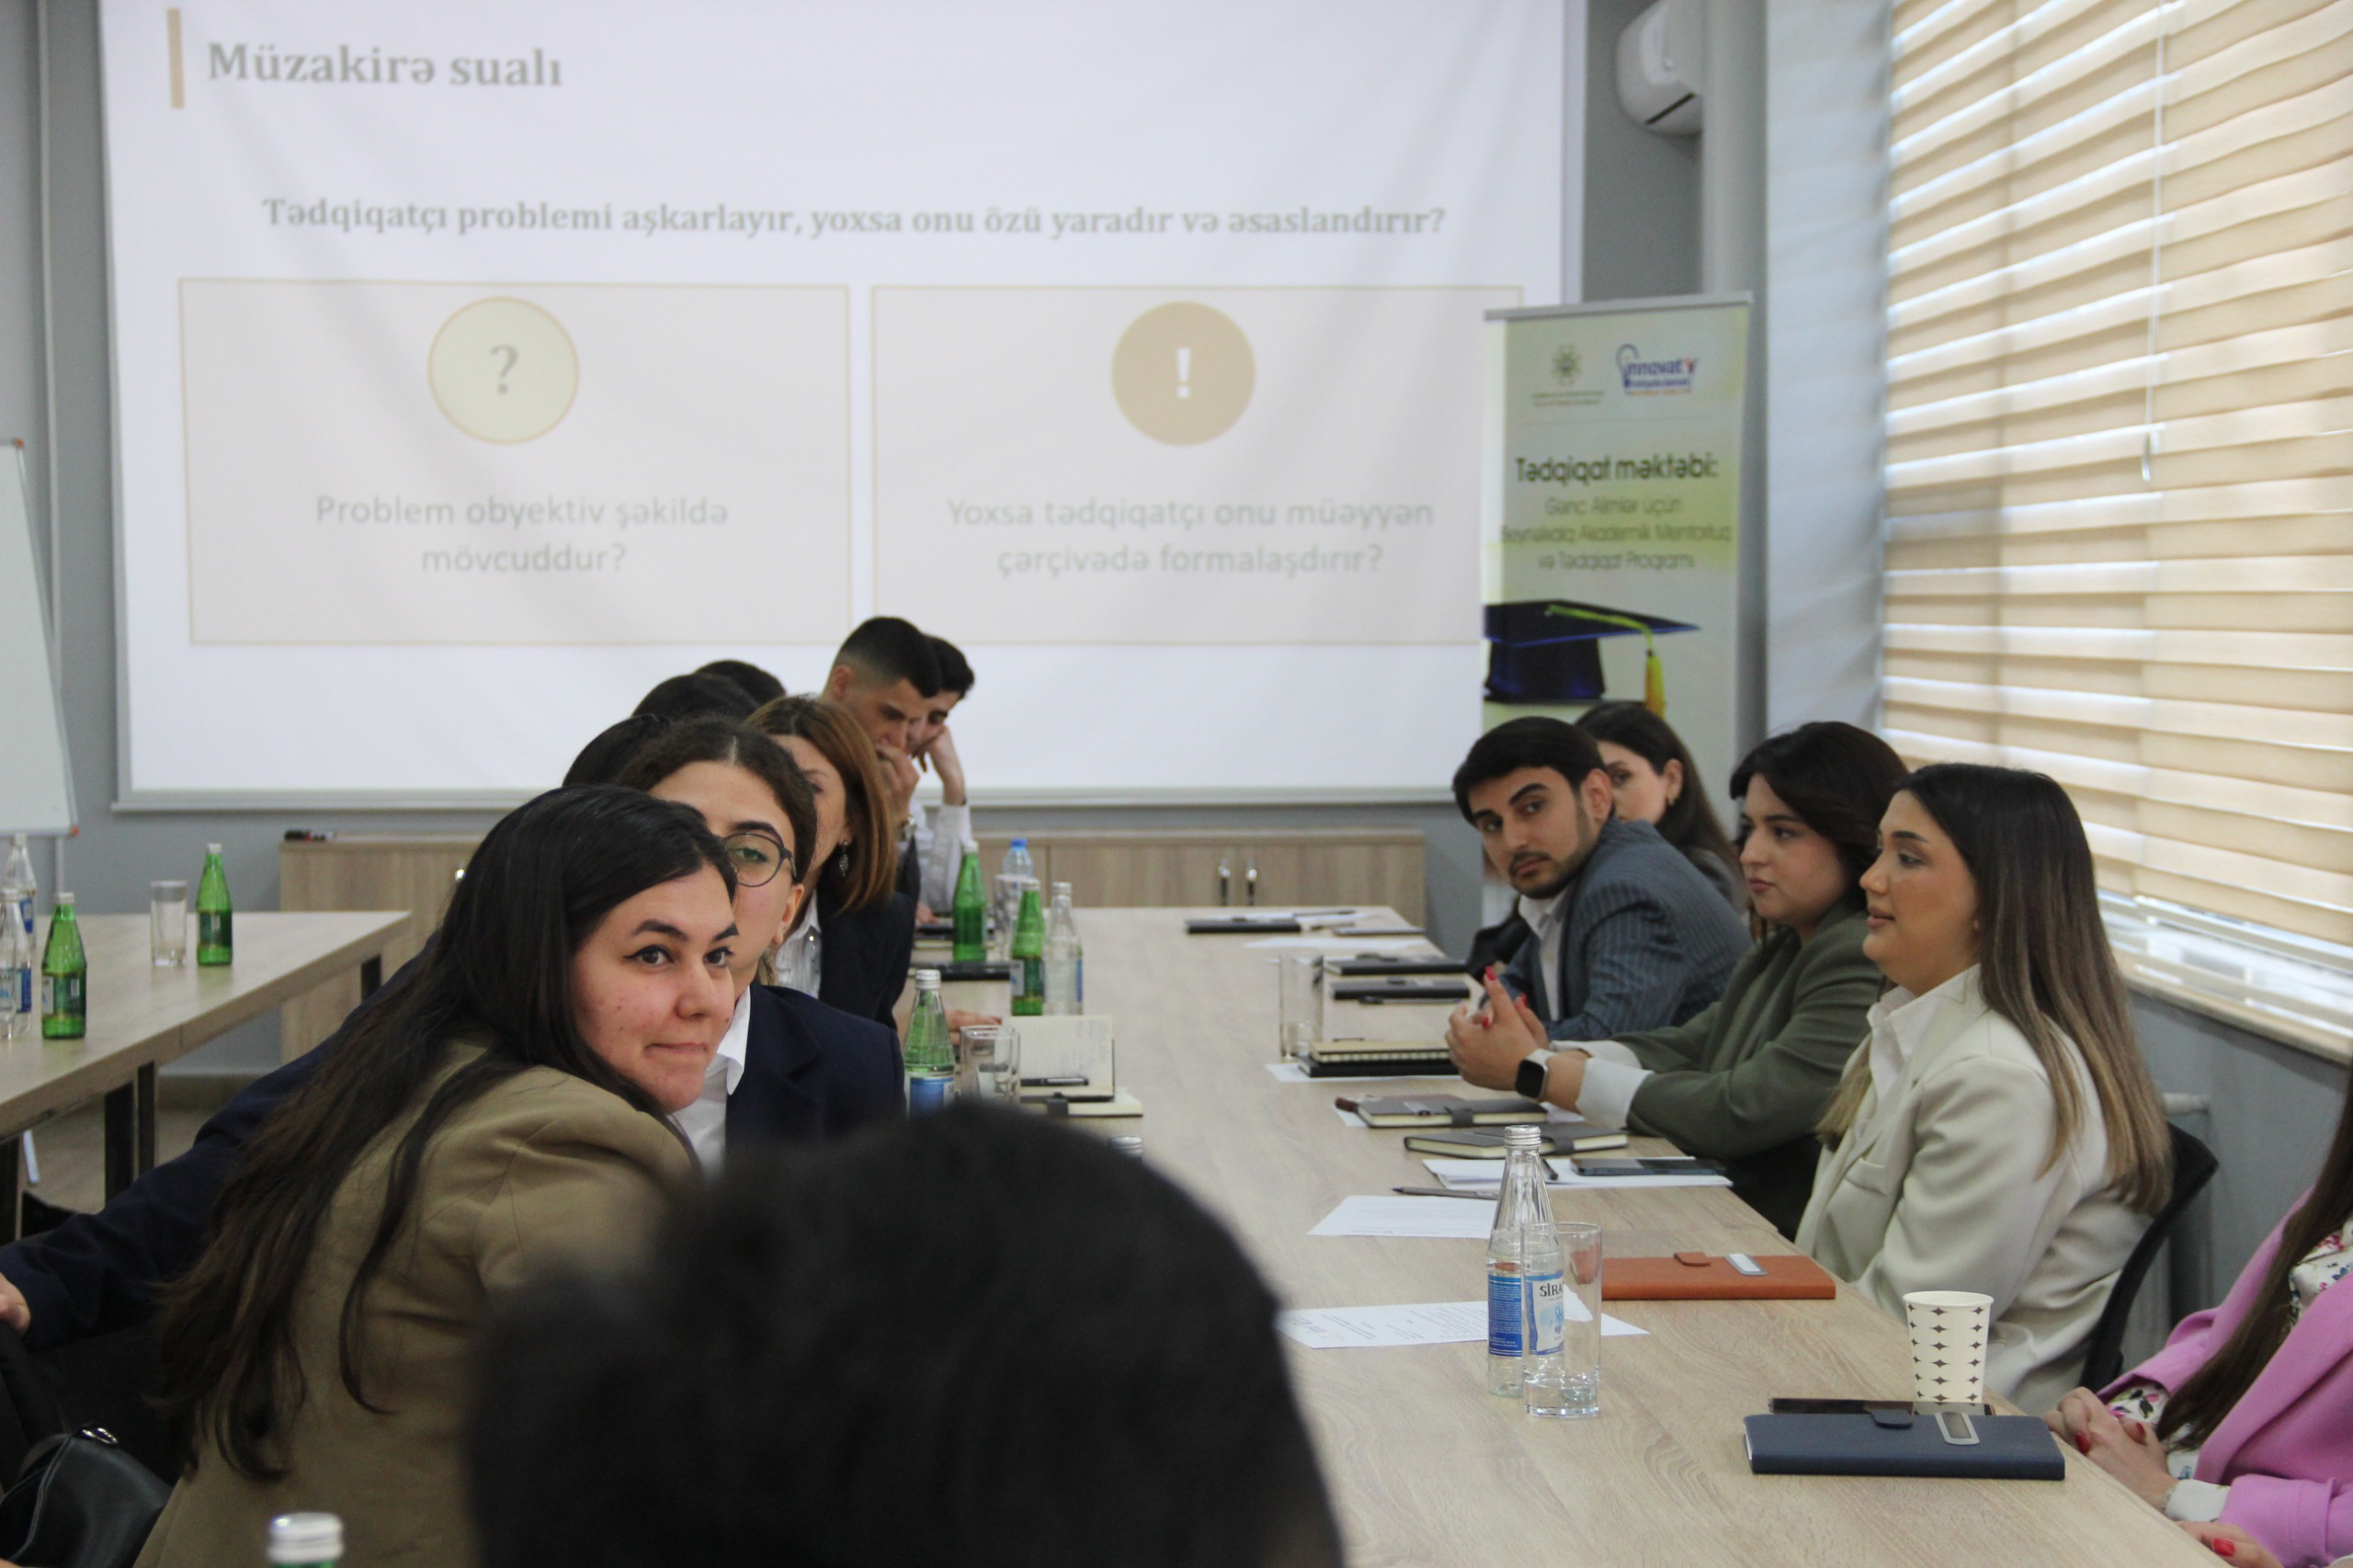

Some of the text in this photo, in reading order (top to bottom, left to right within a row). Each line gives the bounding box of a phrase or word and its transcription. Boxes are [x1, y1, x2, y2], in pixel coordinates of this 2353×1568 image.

[208, 42, 563, 87] Müzakirə sualı
[262, 198, 1448, 242] Tədqiqatçı problemi aşkarlayır, yoxsa onu özü yaradır və əsaslandırır?
[489, 344, 521, 396] ?
[1515, 455, 1611, 486] Tədqiqat
[315, 495, 729, 532] Problem obyektiv şəkildə
[947, 497, 1436, 533] Yoxsa tədqiqatçı onu müəyyən
[421, 543, 629, 574] mövcuddur?
[997, 543, 1386, 581] çərçivədə formalaşdırır?
